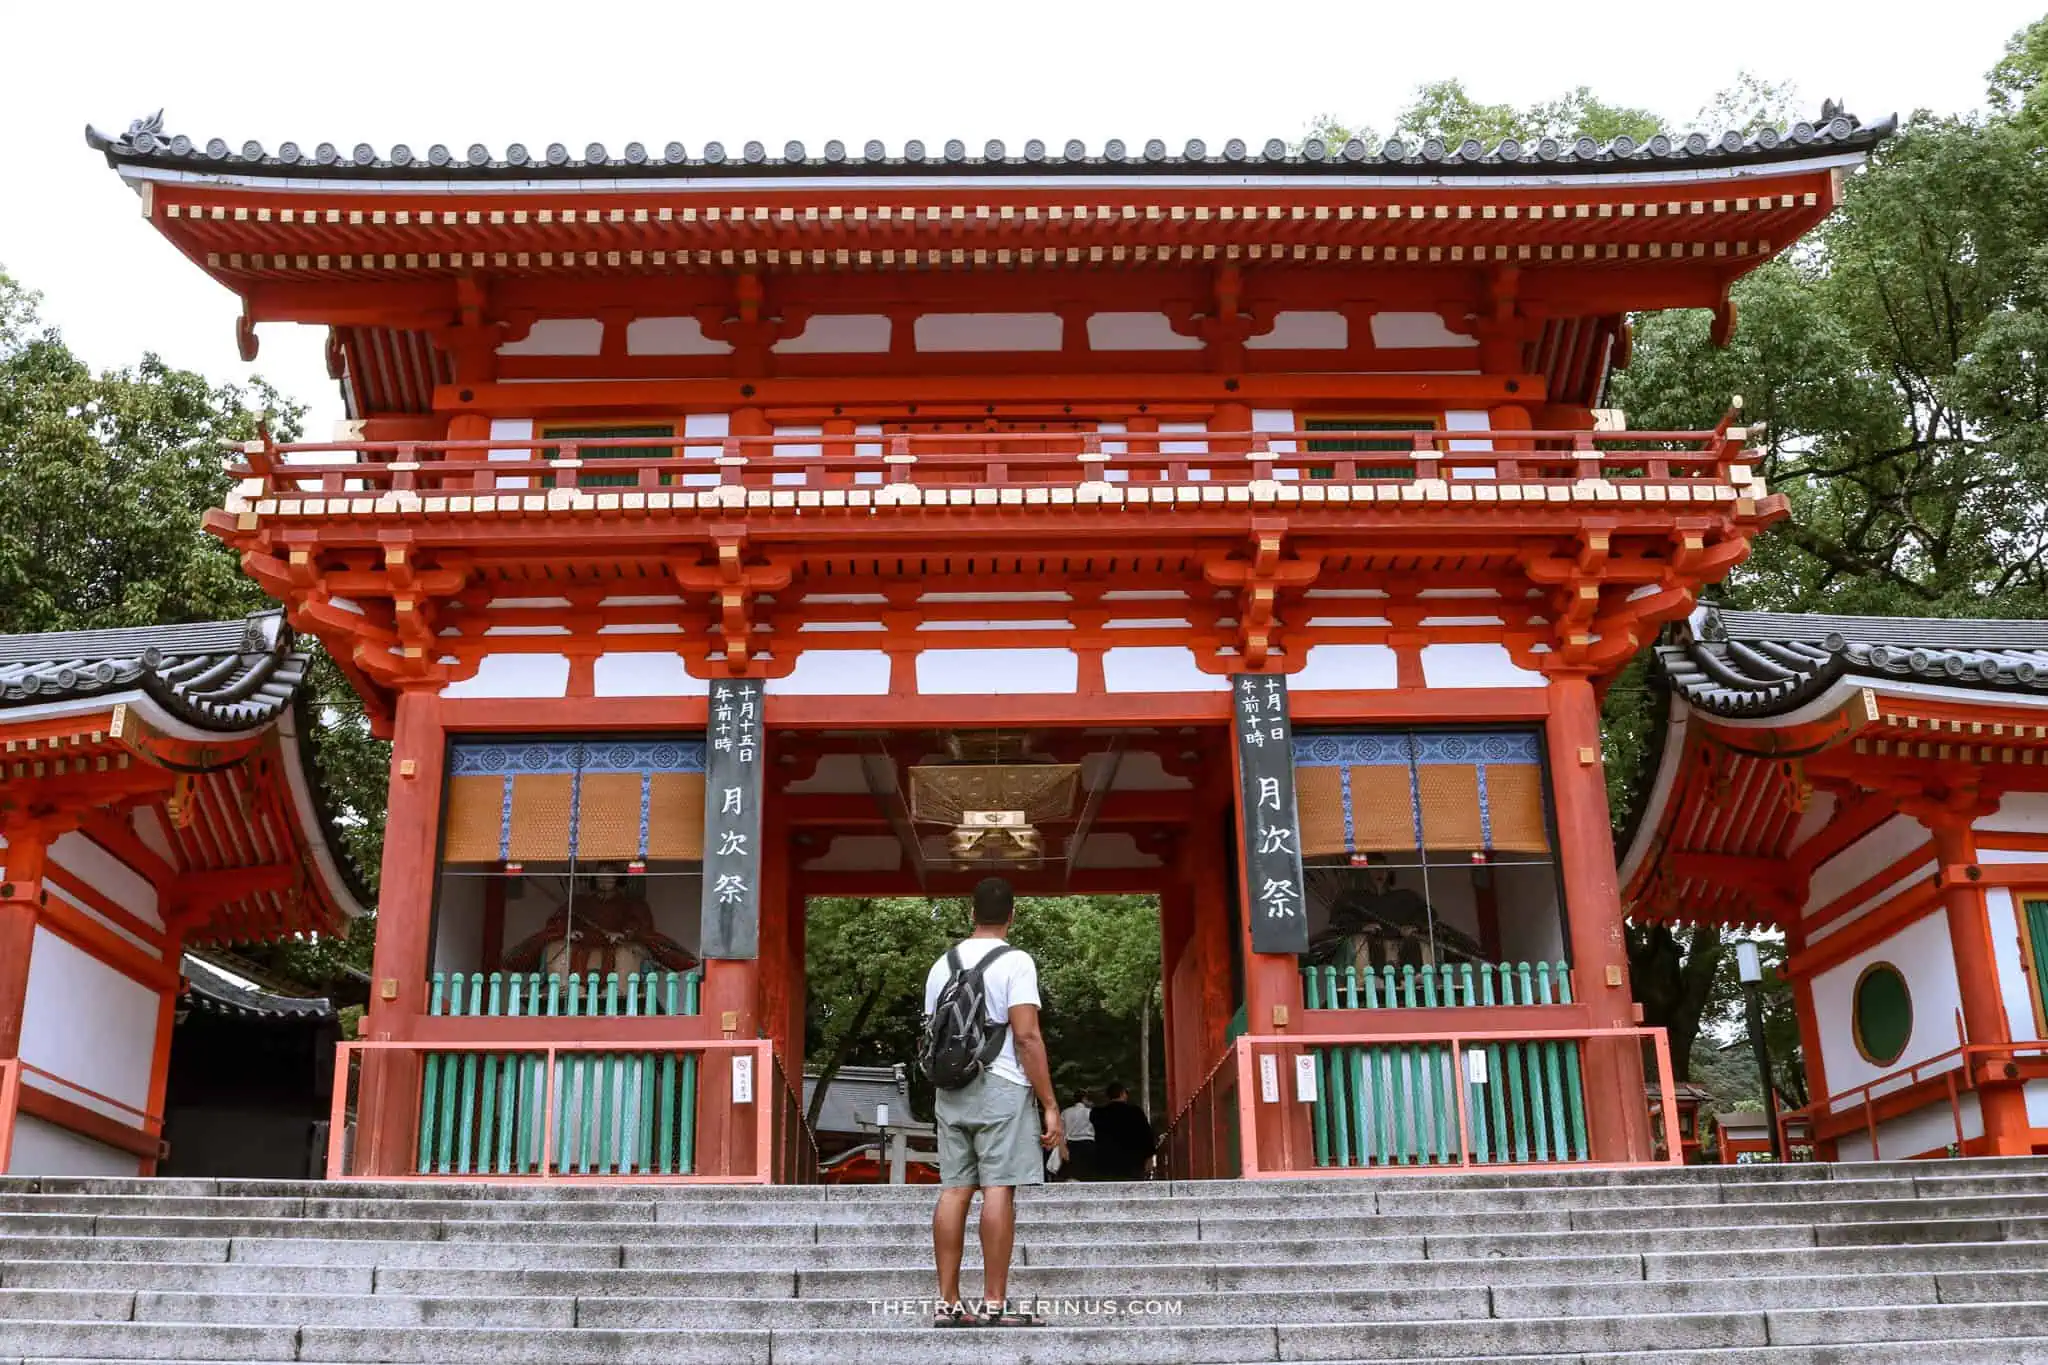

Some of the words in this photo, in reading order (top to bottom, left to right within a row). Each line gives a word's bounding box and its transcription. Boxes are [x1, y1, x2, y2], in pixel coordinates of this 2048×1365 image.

[714, 686, 734, 753] 午前十時
[737, 684, 757, 762] 十月十五日
[1241, 679, 1265, 748] 午前十時
[1264, 678, 1284, 741] 十月一日
[713, 786, 749, 904] 月次祭
[1256, 776, 1300, 919] 月次祭
